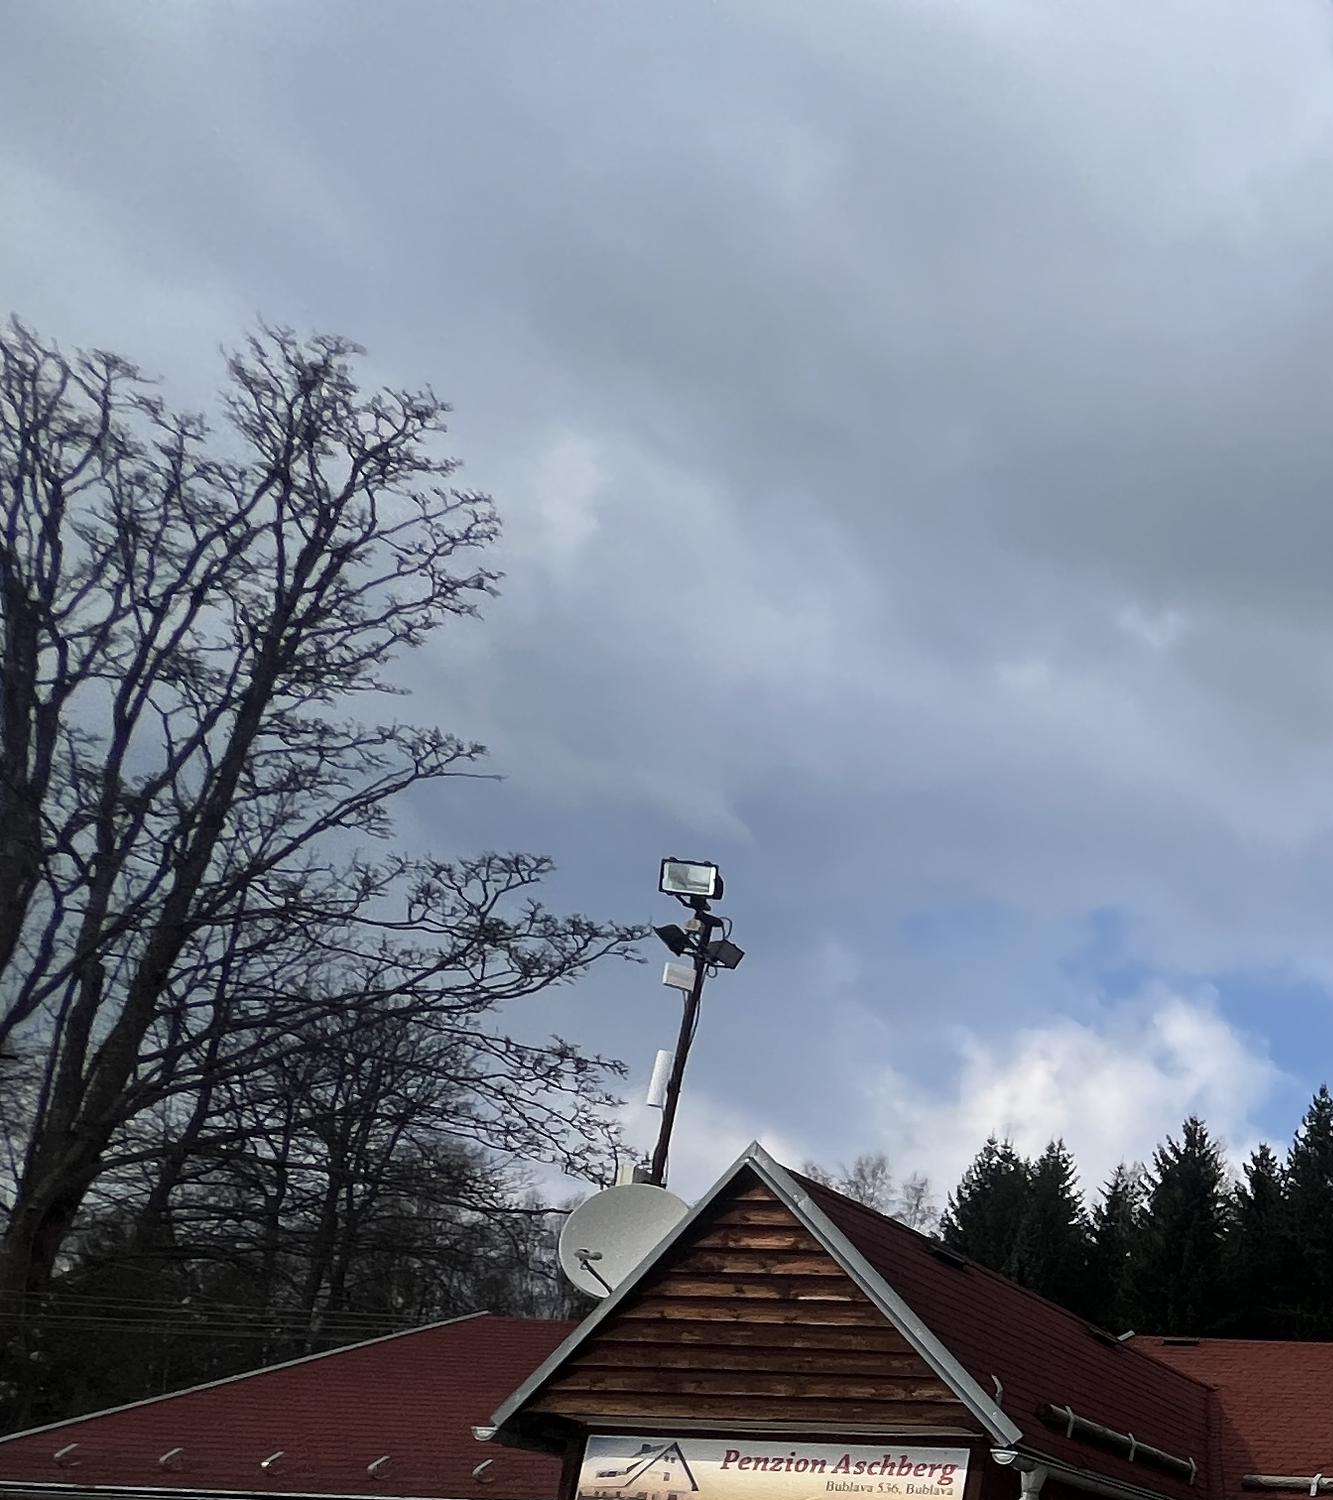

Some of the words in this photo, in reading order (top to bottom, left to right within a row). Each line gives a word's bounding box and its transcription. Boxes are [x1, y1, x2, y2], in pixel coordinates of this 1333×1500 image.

[720, 1449, 827, 1474] Penzion
[831, 1453, 959, 1486] Aschberg
[825, 1480, 874, 1493] Bublava
[905, 1483, 954, 1496] Bublava
